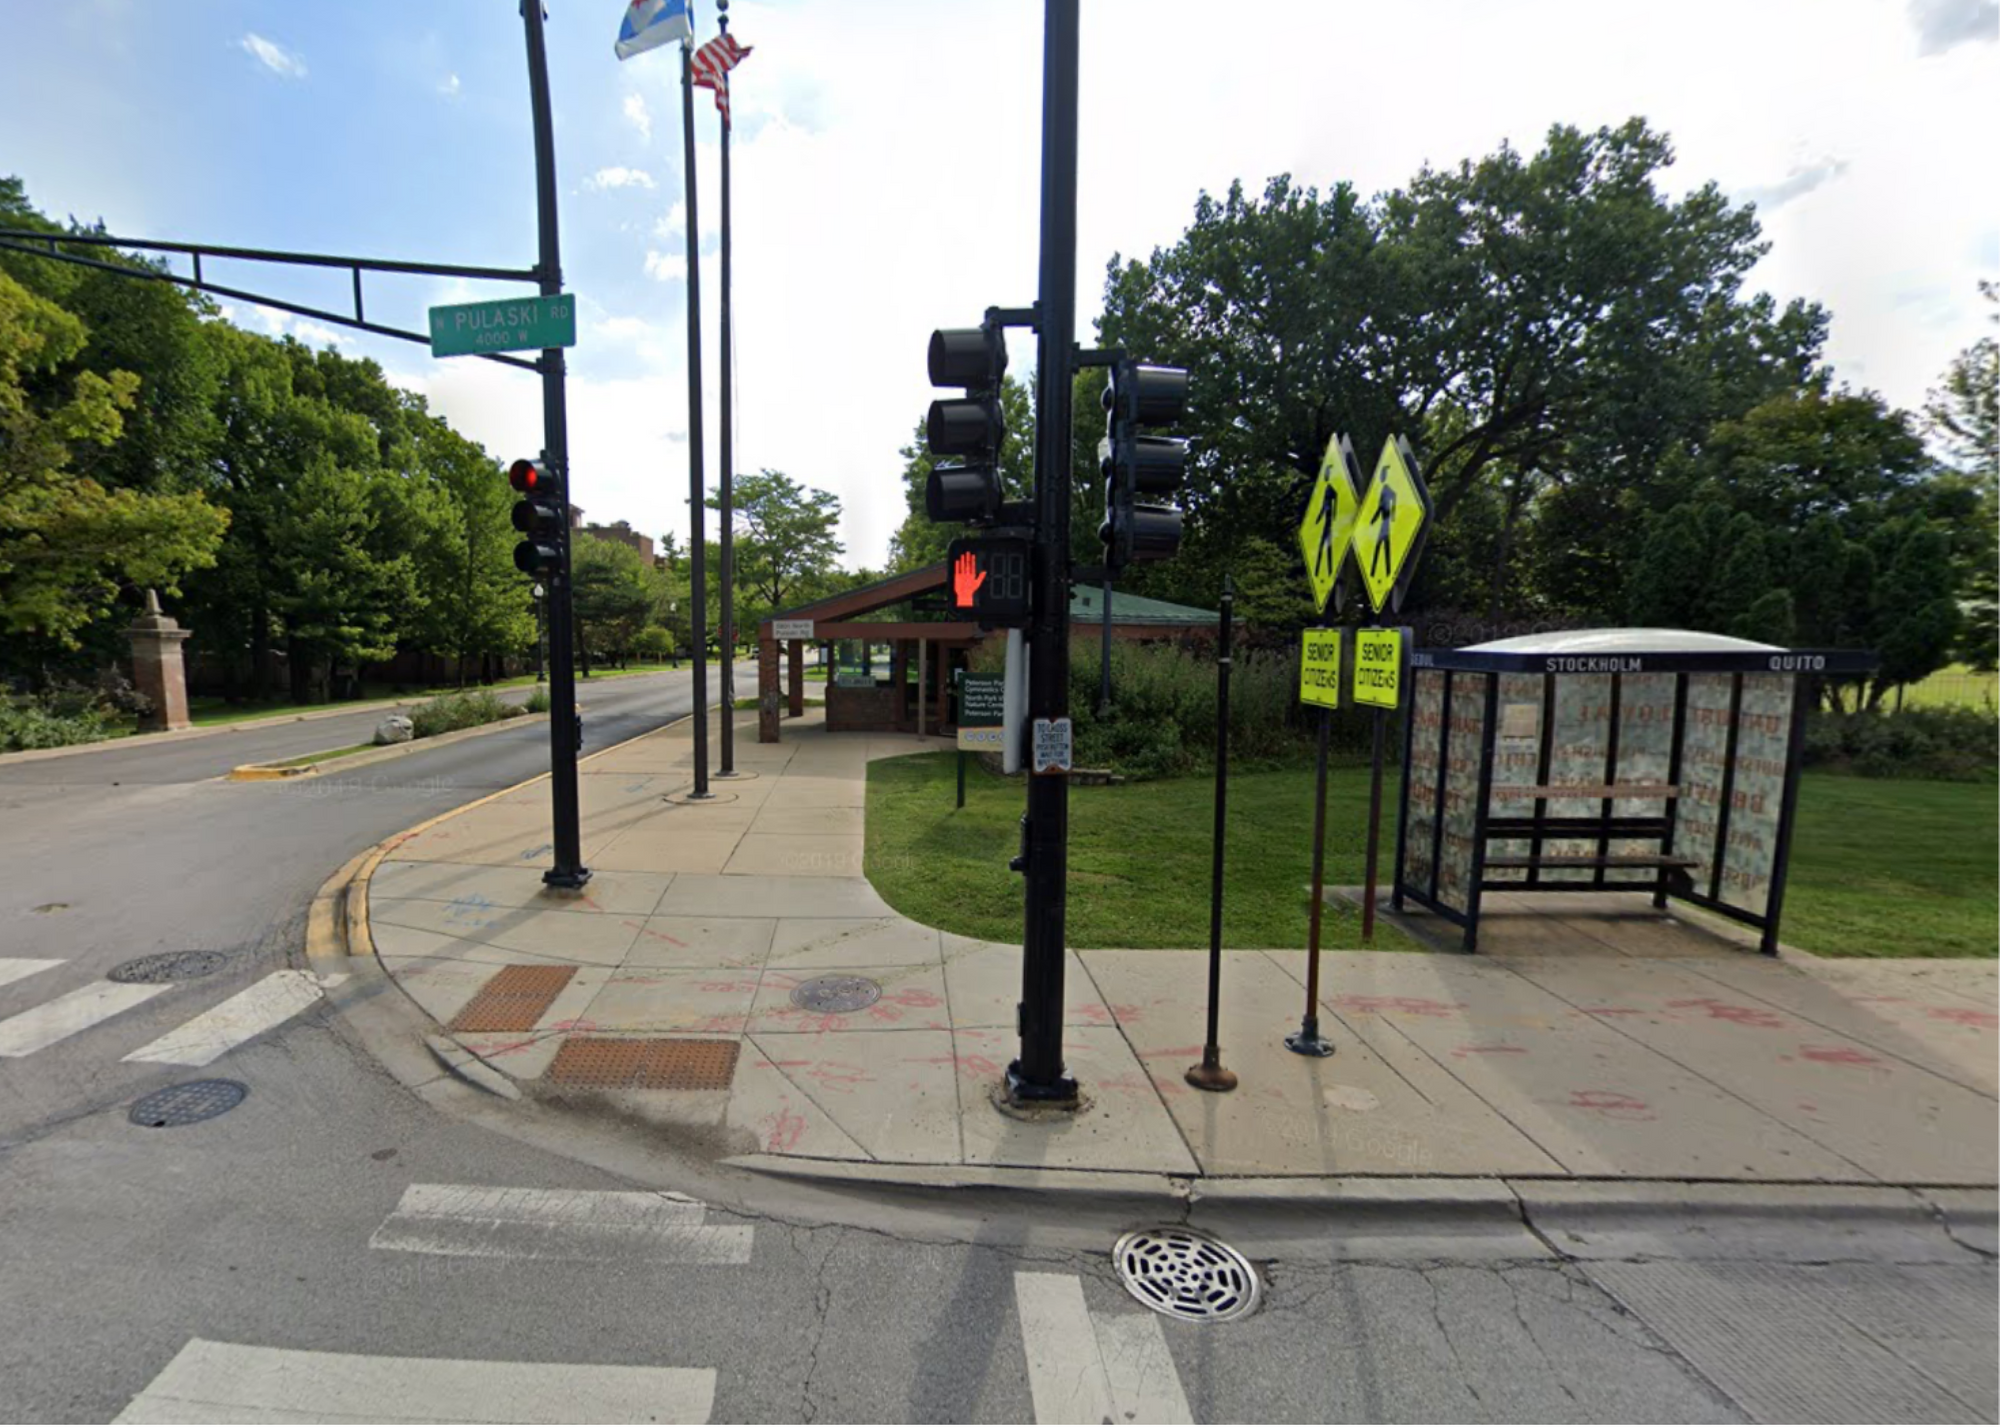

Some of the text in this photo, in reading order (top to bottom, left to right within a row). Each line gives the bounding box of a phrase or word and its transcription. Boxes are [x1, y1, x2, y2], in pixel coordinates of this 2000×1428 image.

[455, 304, 538, 331] PULASKI
[550, 305, 568, 319] RD
[475, 329, 528, 346] 4000 W
[1307, 642, 1334, 662] SENIOR
[1362, 643, 1394, 662] SENIOR
[1546, 657, 1642, 673] STOCKHOLM
[1769, 655, 1826, 671] QUITO
[994, 679, 1005, 687] Par
[1304, 667, 1336, 689] CITIZENS
[1358, 667, 1395, 690] CITIZENS
[1041, 733, 1064, 743] STREET
